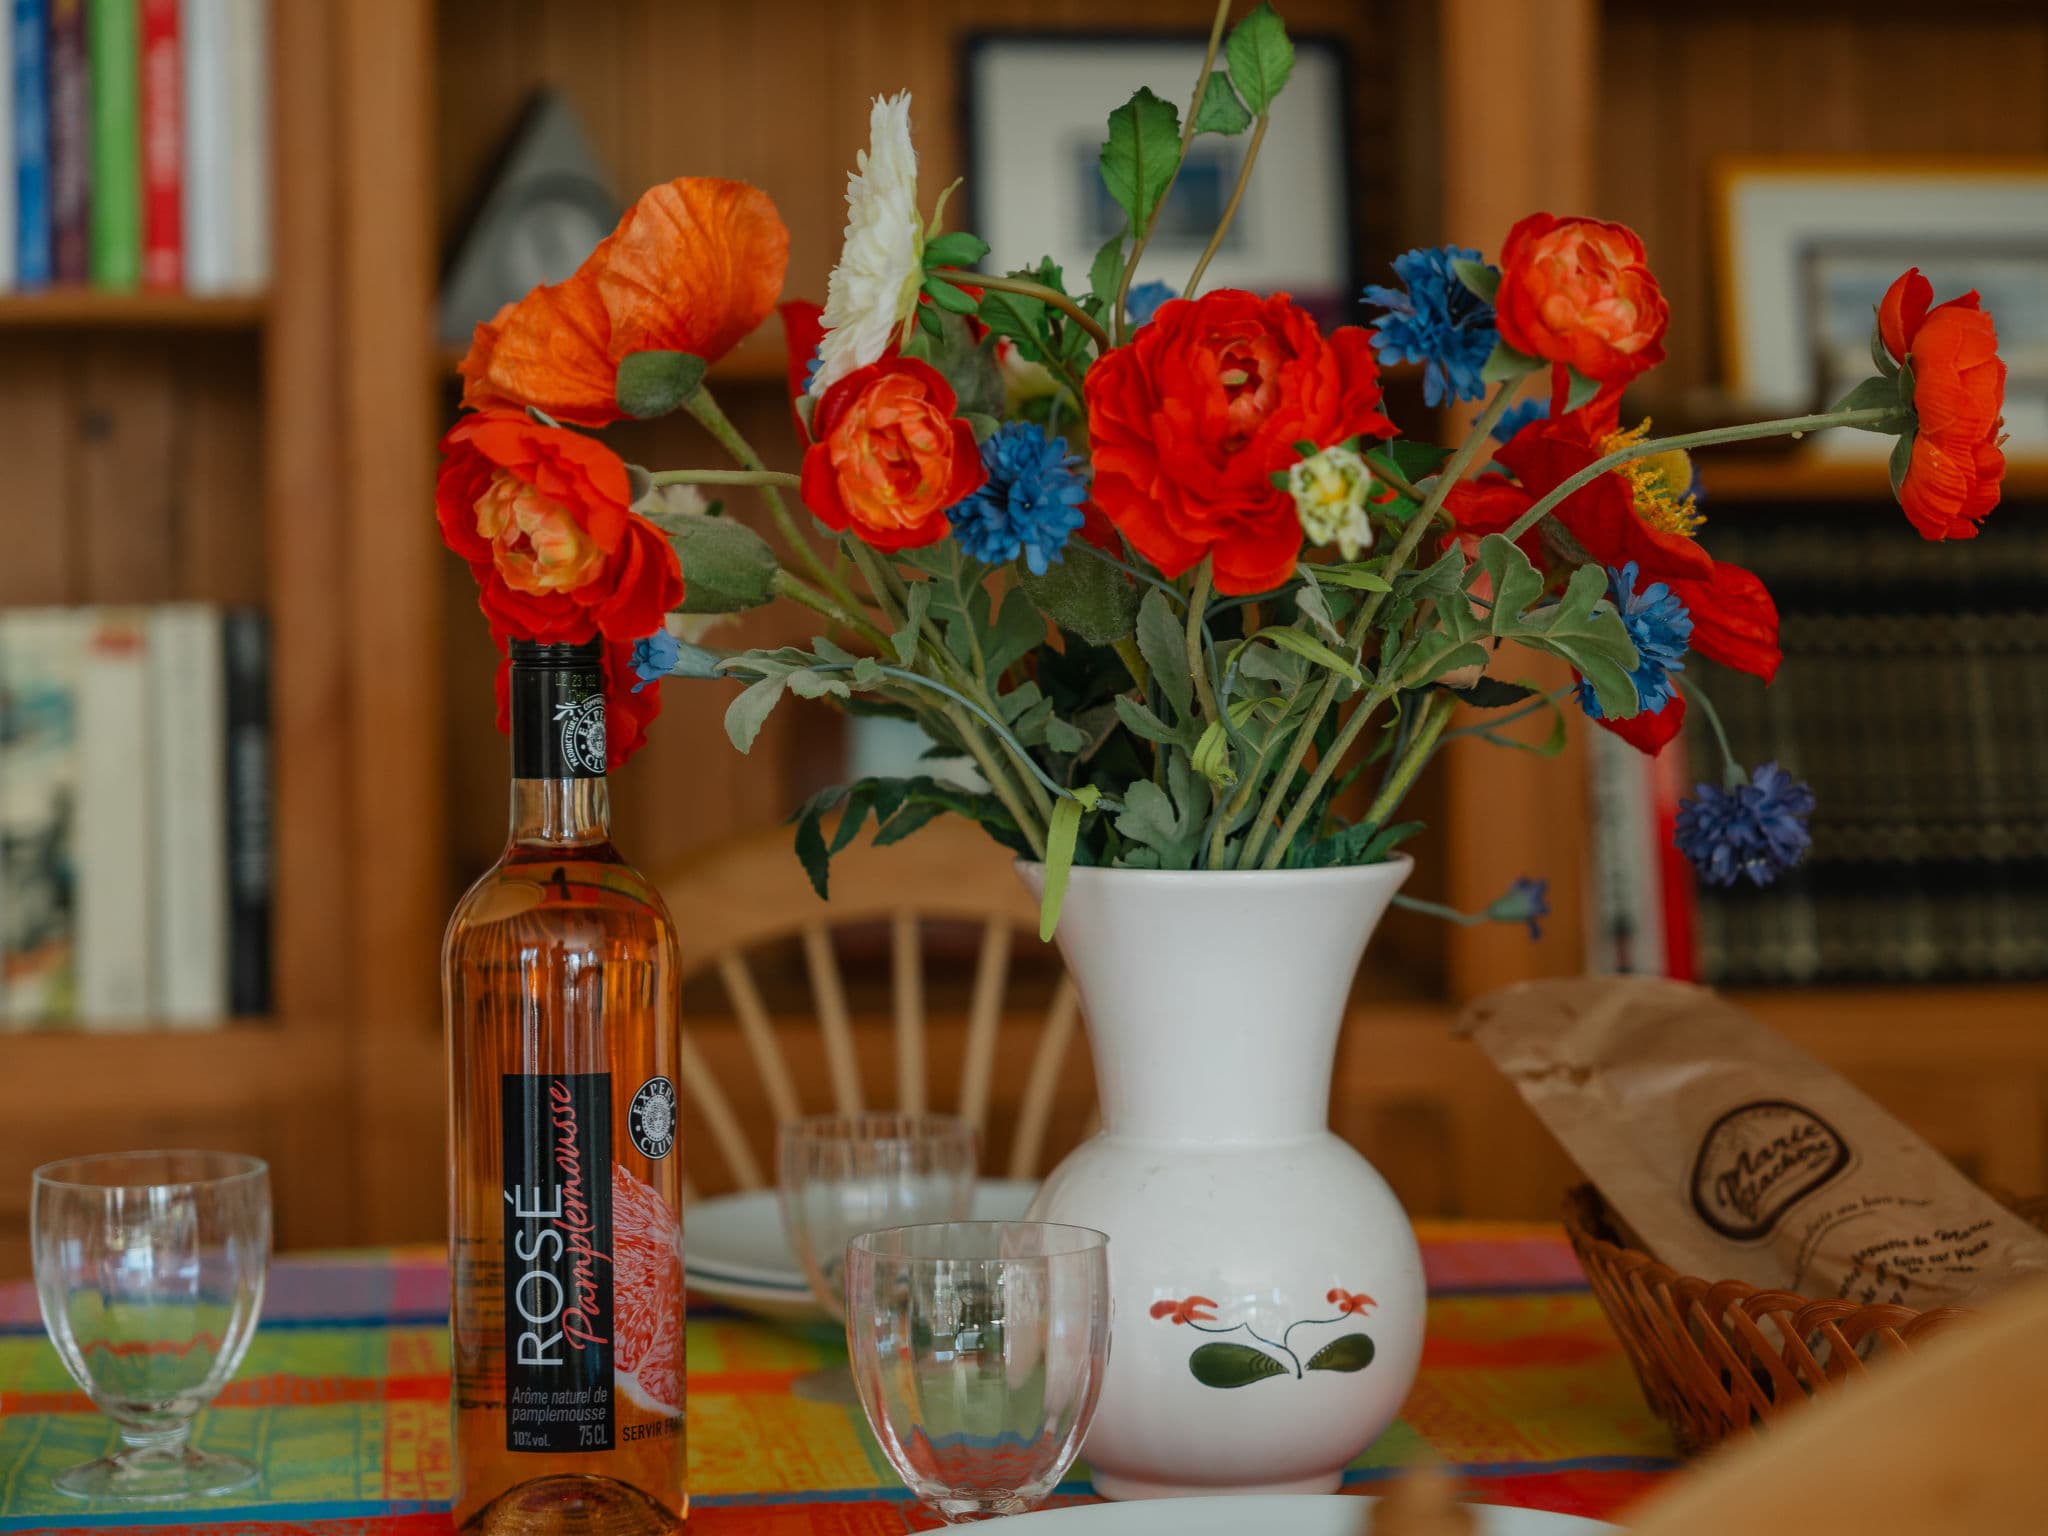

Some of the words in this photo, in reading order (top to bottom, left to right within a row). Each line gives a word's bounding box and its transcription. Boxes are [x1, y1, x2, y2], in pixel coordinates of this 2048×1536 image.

[577, 709, 607, 737] EXPE
[565, 716, 580, 767] PRODUCTEURS
[585, 753, 606, 769] CLU
[549, 1079, 613, 1351] Pamplemousse
[503, 1183, 564, 1366] ROSÉ
[512, 1386, 548, 1404] Arôme
[551, 1385, 591, 1405] naturel
[593, 1386, 608, 1403] de
[512, 1405, 606, 1425] pamplemousse
[622, 1421, 662, 1442] SERVIR
